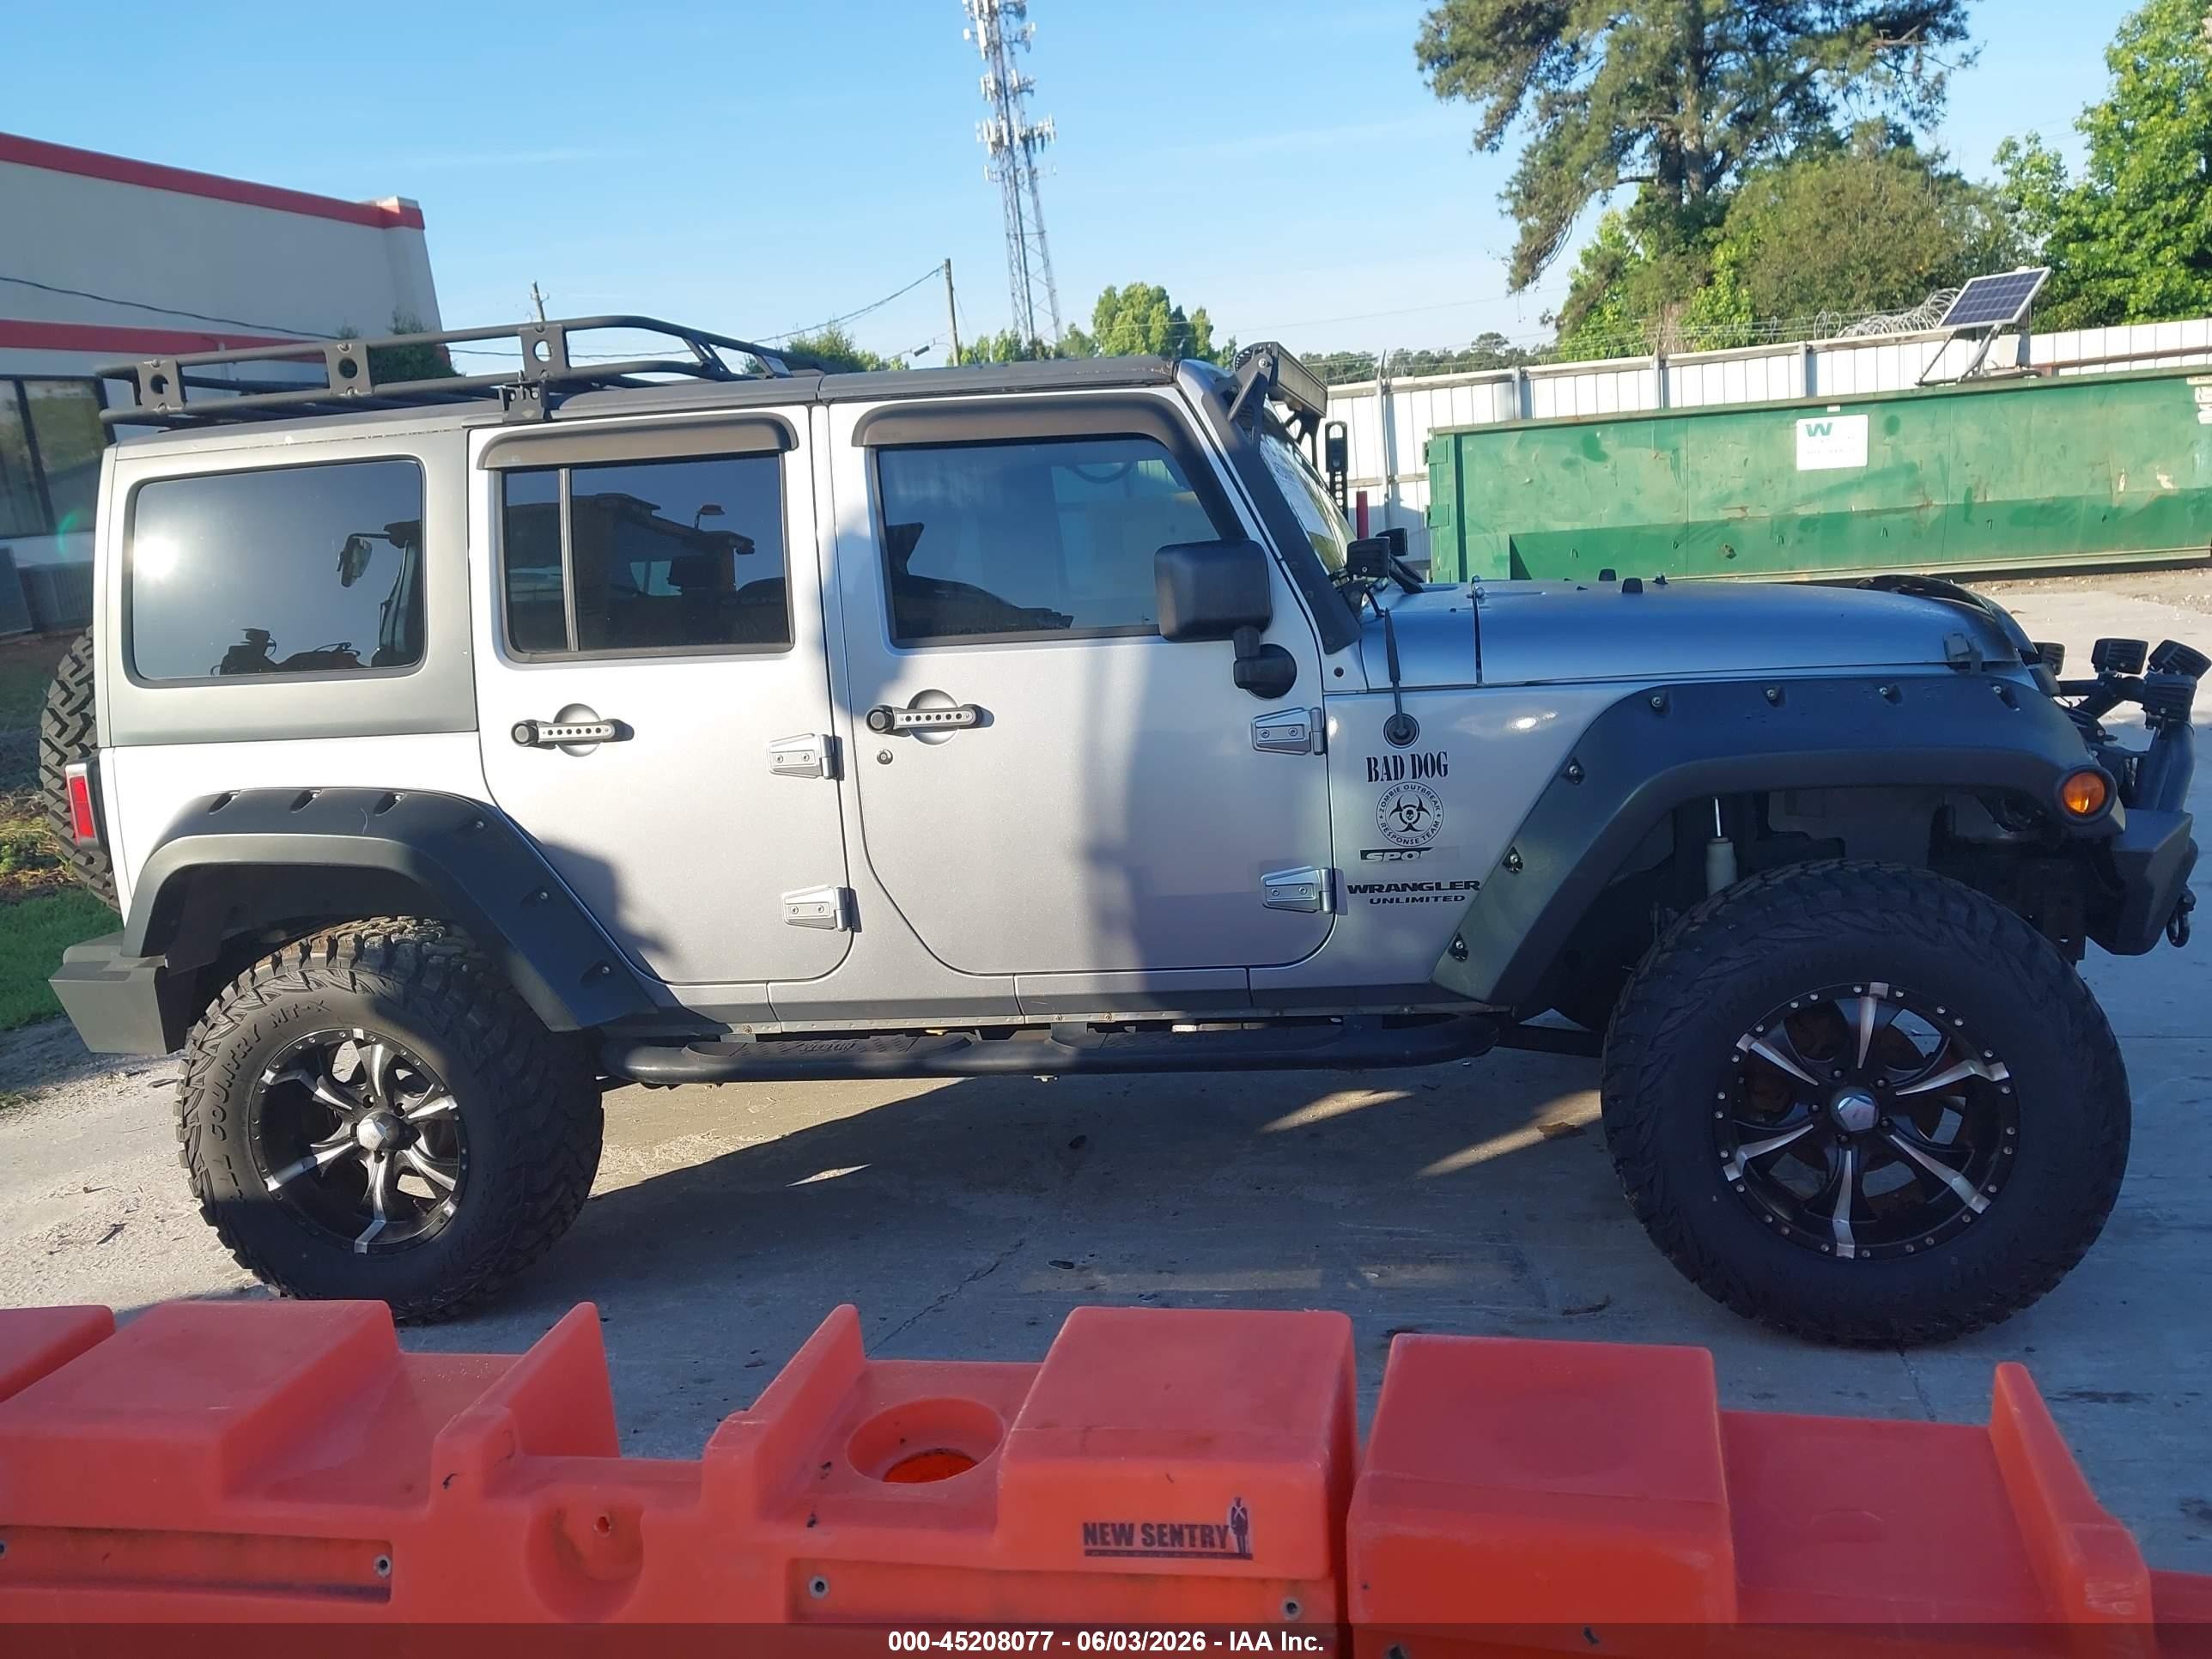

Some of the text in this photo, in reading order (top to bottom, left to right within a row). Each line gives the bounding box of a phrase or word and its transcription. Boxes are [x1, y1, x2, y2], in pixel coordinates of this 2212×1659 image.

[1365, 750, 1449, 783] BAD DOG
[1378, 784, 1441, 812] ZOMBIE OUTBREAK
[1380, 820, 1440, 845] RESPONSE TEAM
[1346, 880, 1480, 894] WRANGLER
[1369, 895, 1466, 905] UNLIMITED
[211, 1023, 262, 1141] COUNTRY
[1083, 1522, 1230, 1549] NEW SENTRY
